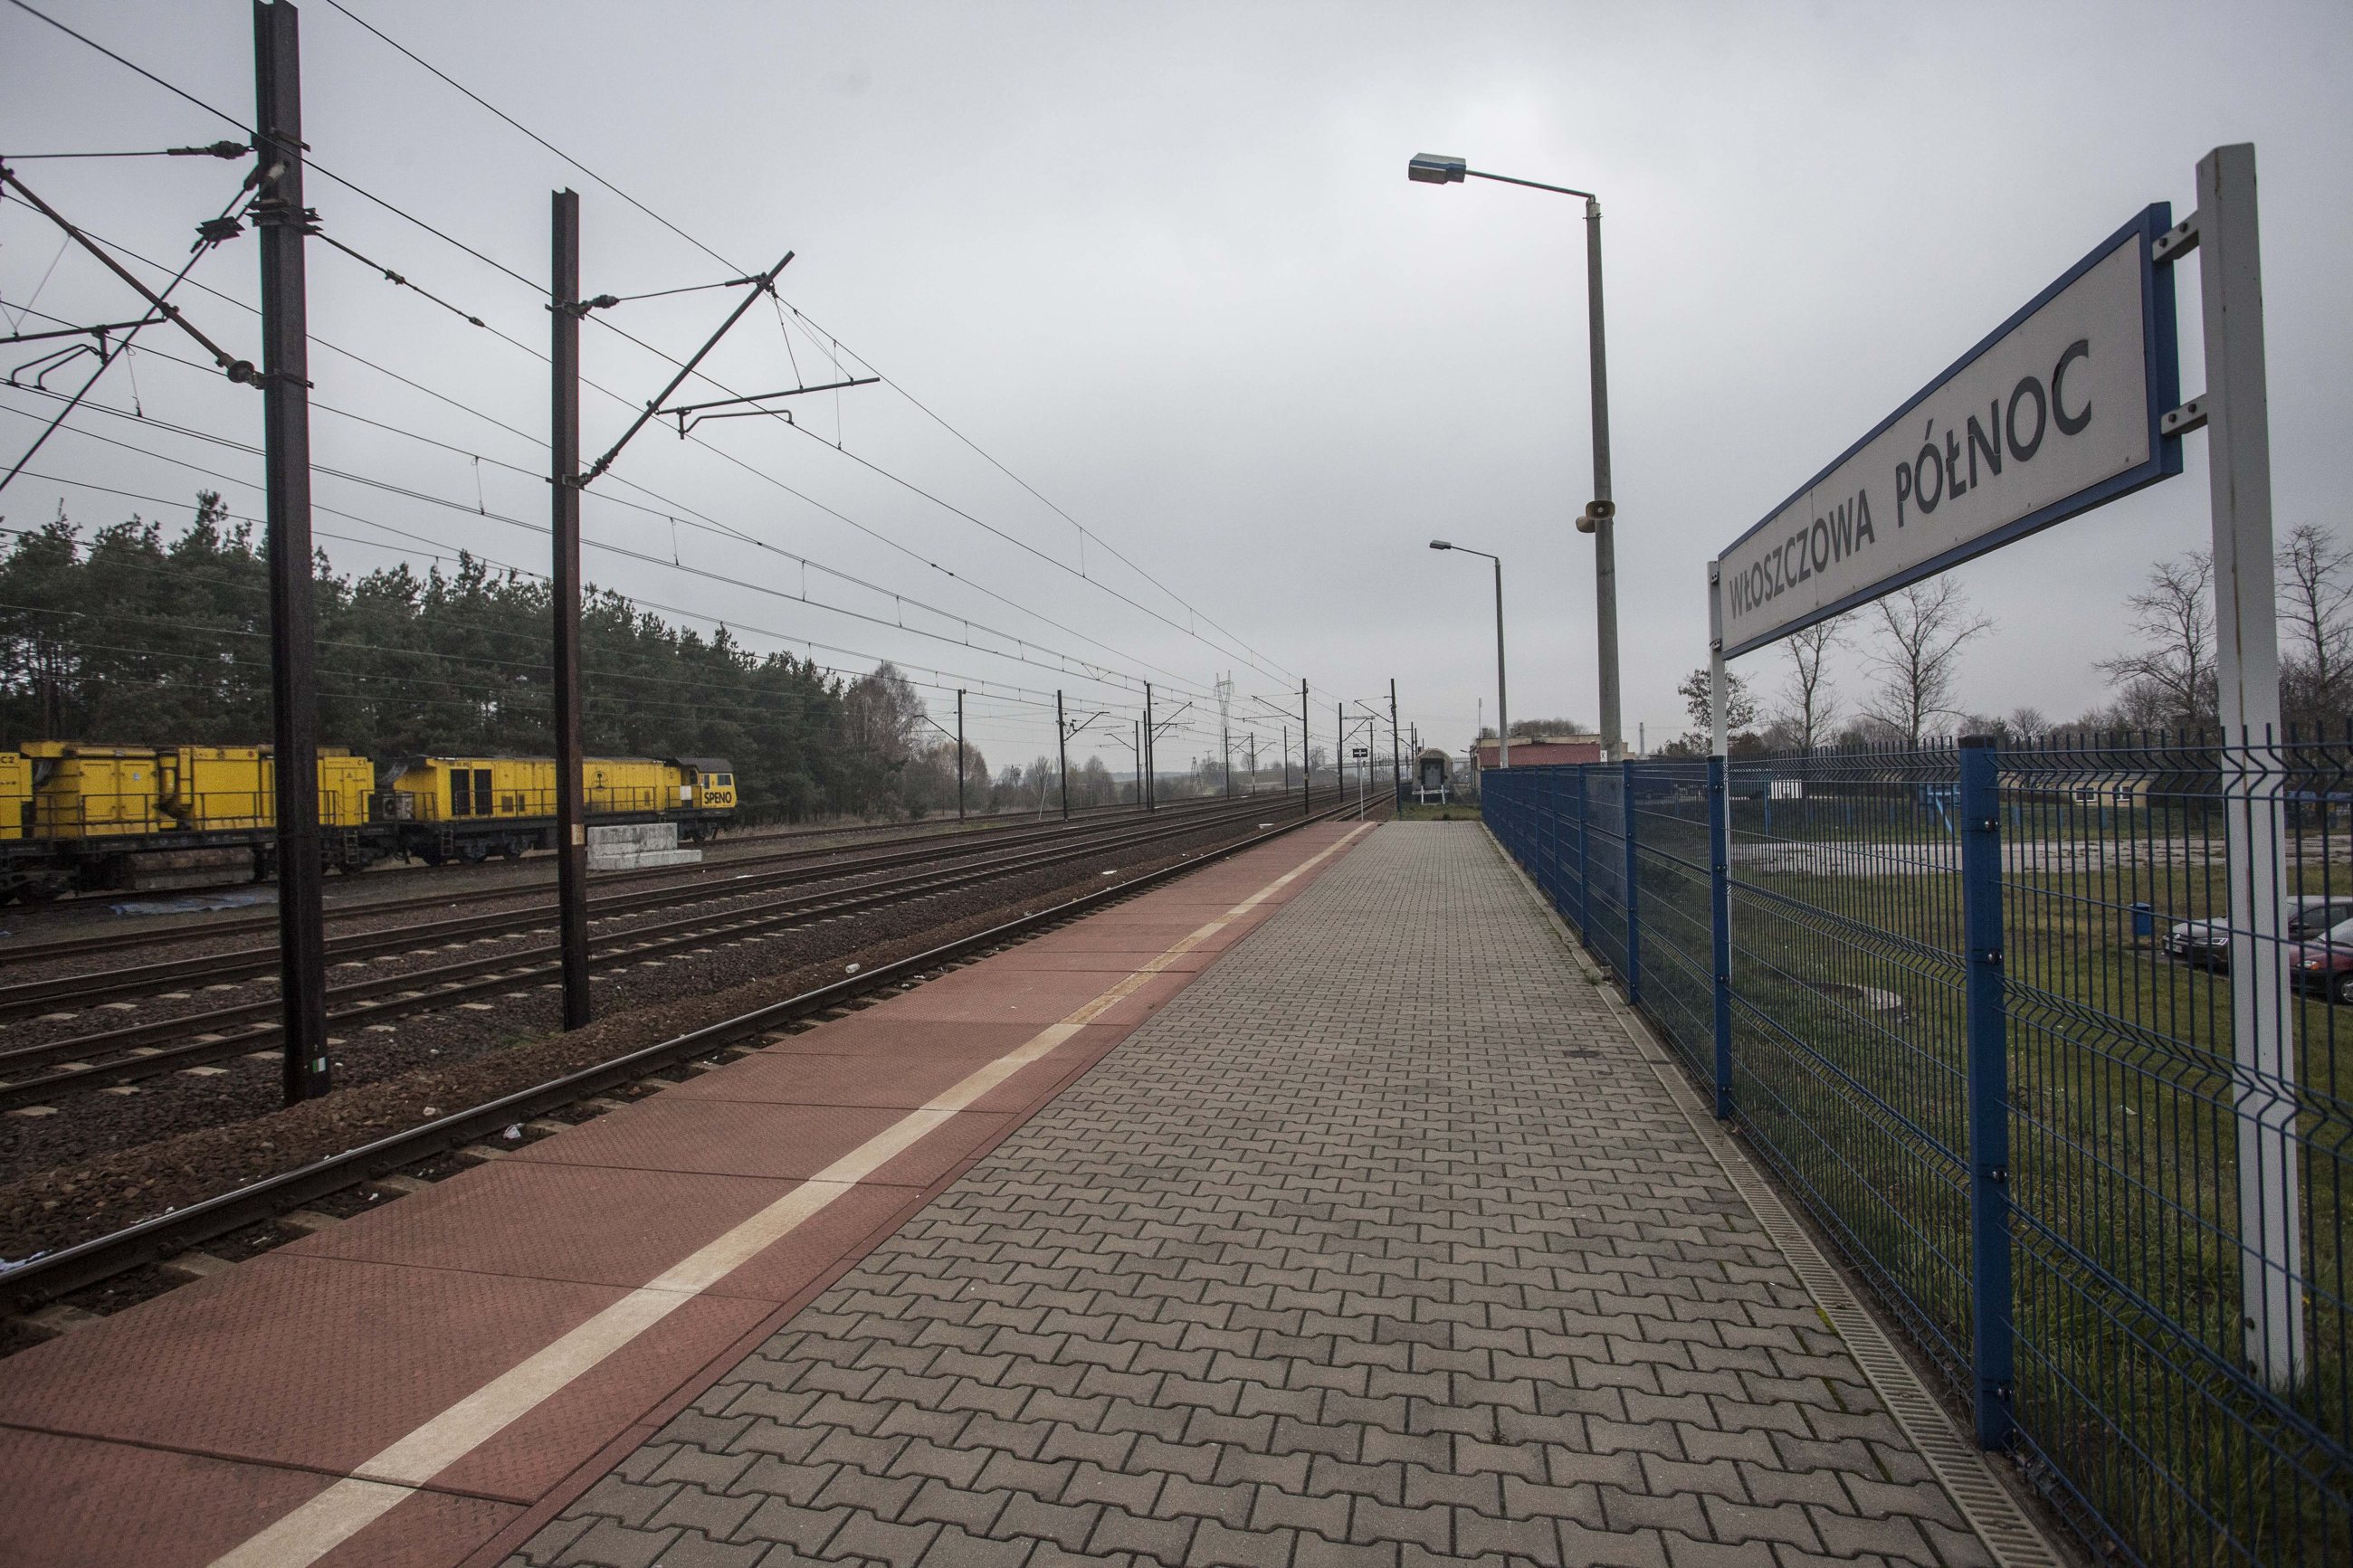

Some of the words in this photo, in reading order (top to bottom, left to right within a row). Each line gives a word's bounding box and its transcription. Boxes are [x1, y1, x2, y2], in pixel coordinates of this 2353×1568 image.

[1729, 489, 1875, 619] WŁOSZCZOWA
[1896, 339, 2091, 528] PÓŁNOC
[704, 791, 732, 804] SPENO
